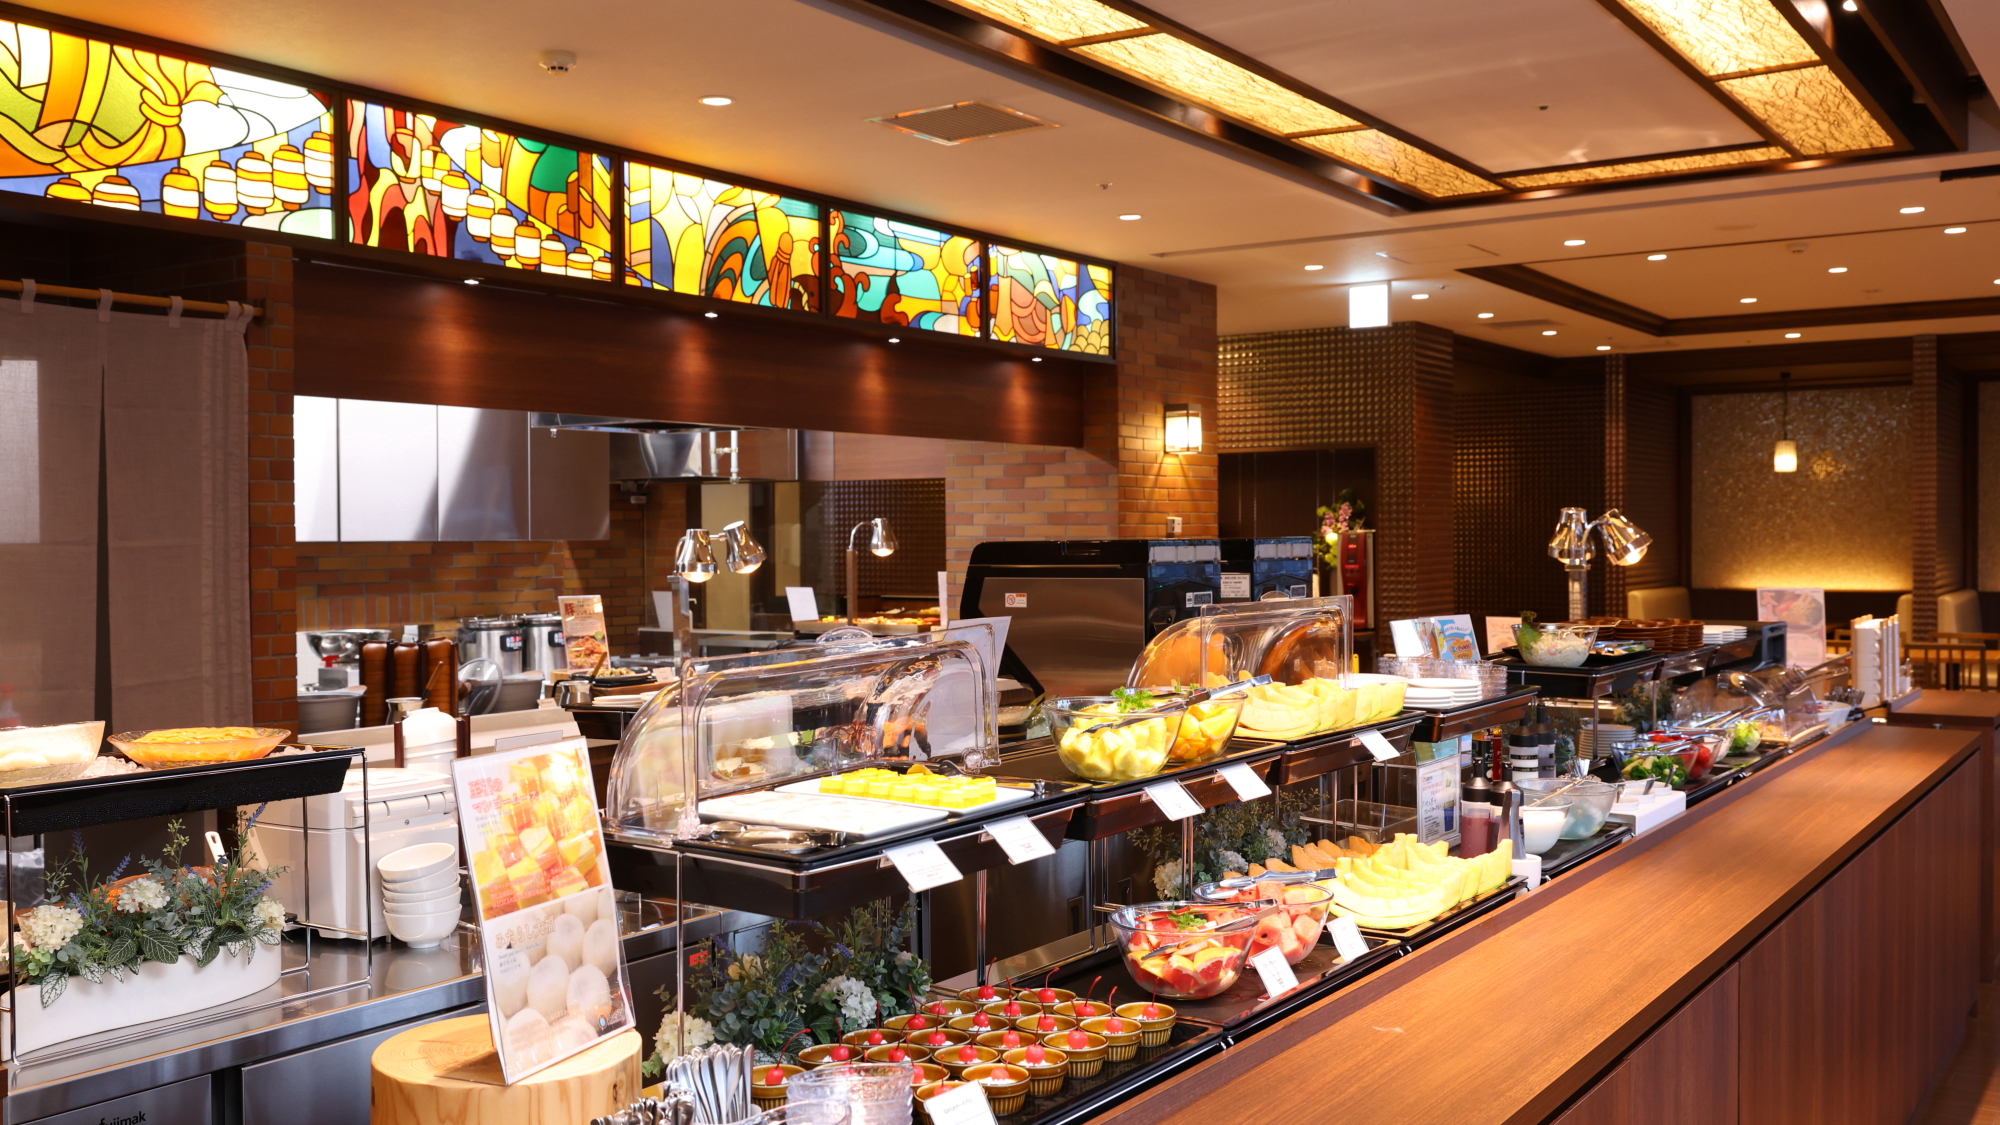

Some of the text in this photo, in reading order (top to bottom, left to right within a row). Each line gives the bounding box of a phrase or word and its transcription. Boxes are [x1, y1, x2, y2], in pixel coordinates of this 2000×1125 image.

[472, 791, 539, 814] マンゴームース
[495, 915, 556, 950] みたらし大福
[99, 1111, 146, 1125] fjimak
